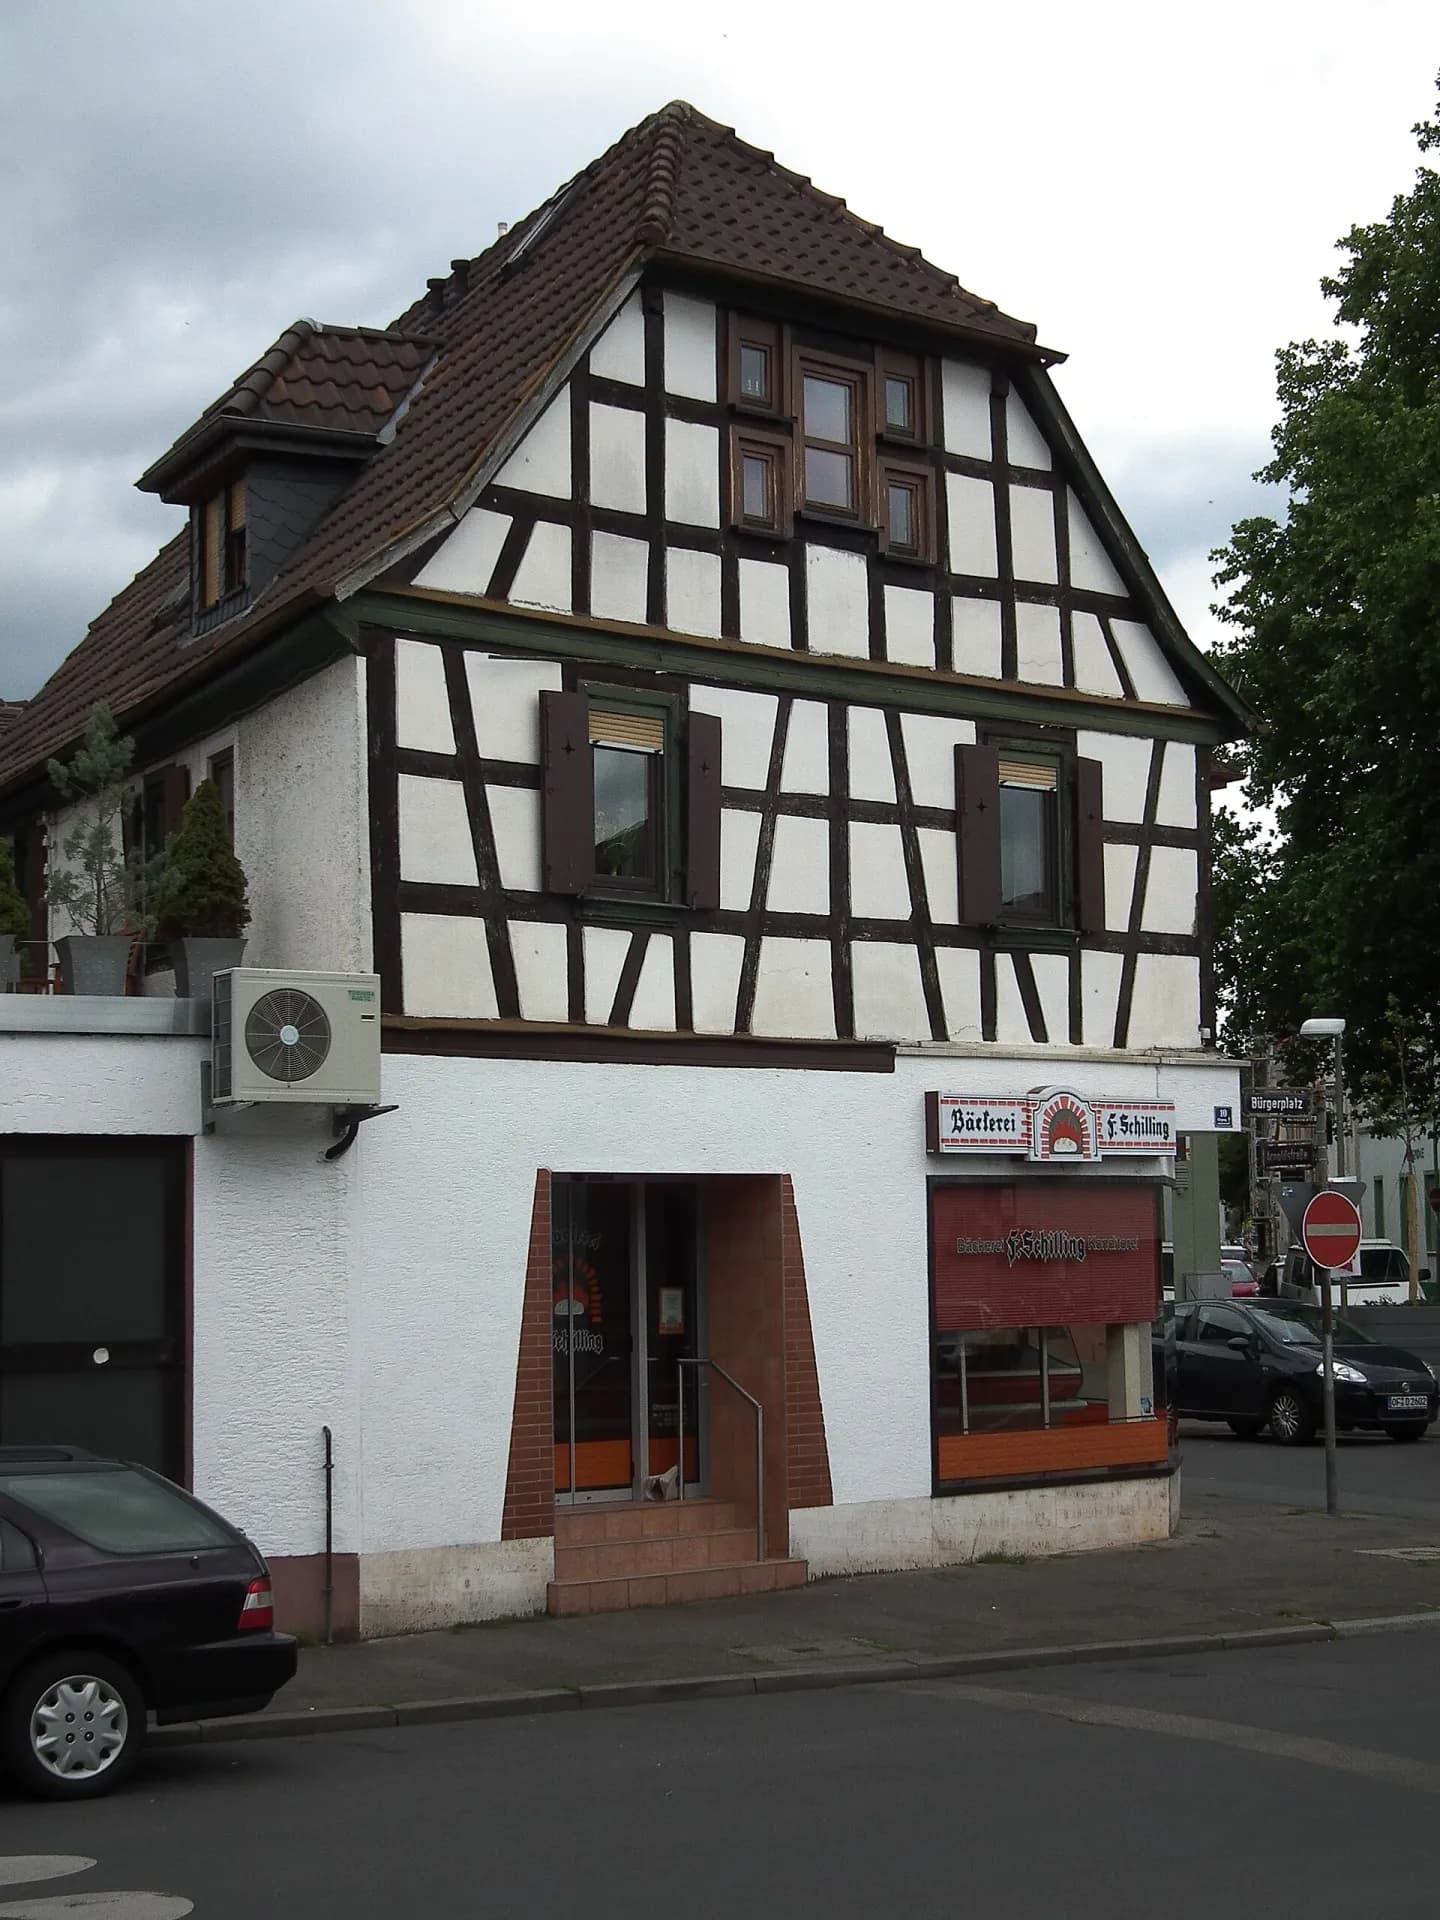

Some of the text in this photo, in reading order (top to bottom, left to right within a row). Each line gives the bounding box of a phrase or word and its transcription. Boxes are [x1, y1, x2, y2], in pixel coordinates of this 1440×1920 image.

[1251, 1096, 1305, 1112] Bürgerplatz
[1219, 1108, 1228, 1117] 10
[951, 1108, 1016, 1134] Bäckerei
[1119, 1113, 1170, 1141] Schilling
